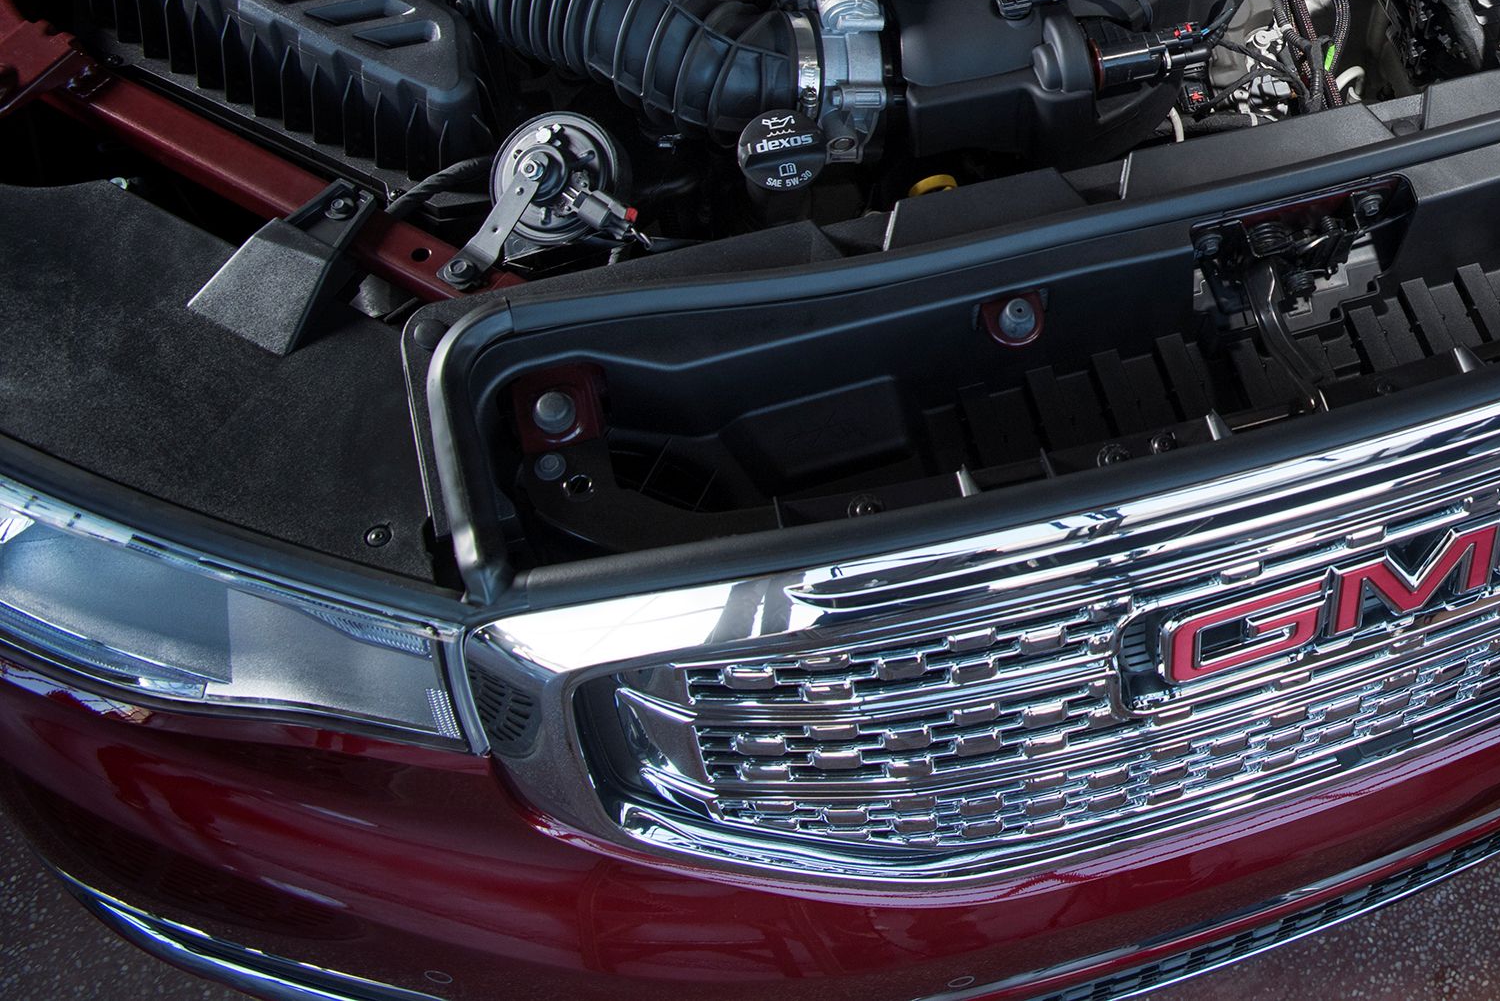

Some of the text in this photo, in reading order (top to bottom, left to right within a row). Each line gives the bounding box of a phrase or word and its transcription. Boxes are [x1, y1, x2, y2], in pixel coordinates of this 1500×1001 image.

[756, 133, 813, 153] dexos
[766, 169, 813, 188] SAE 5W-30
